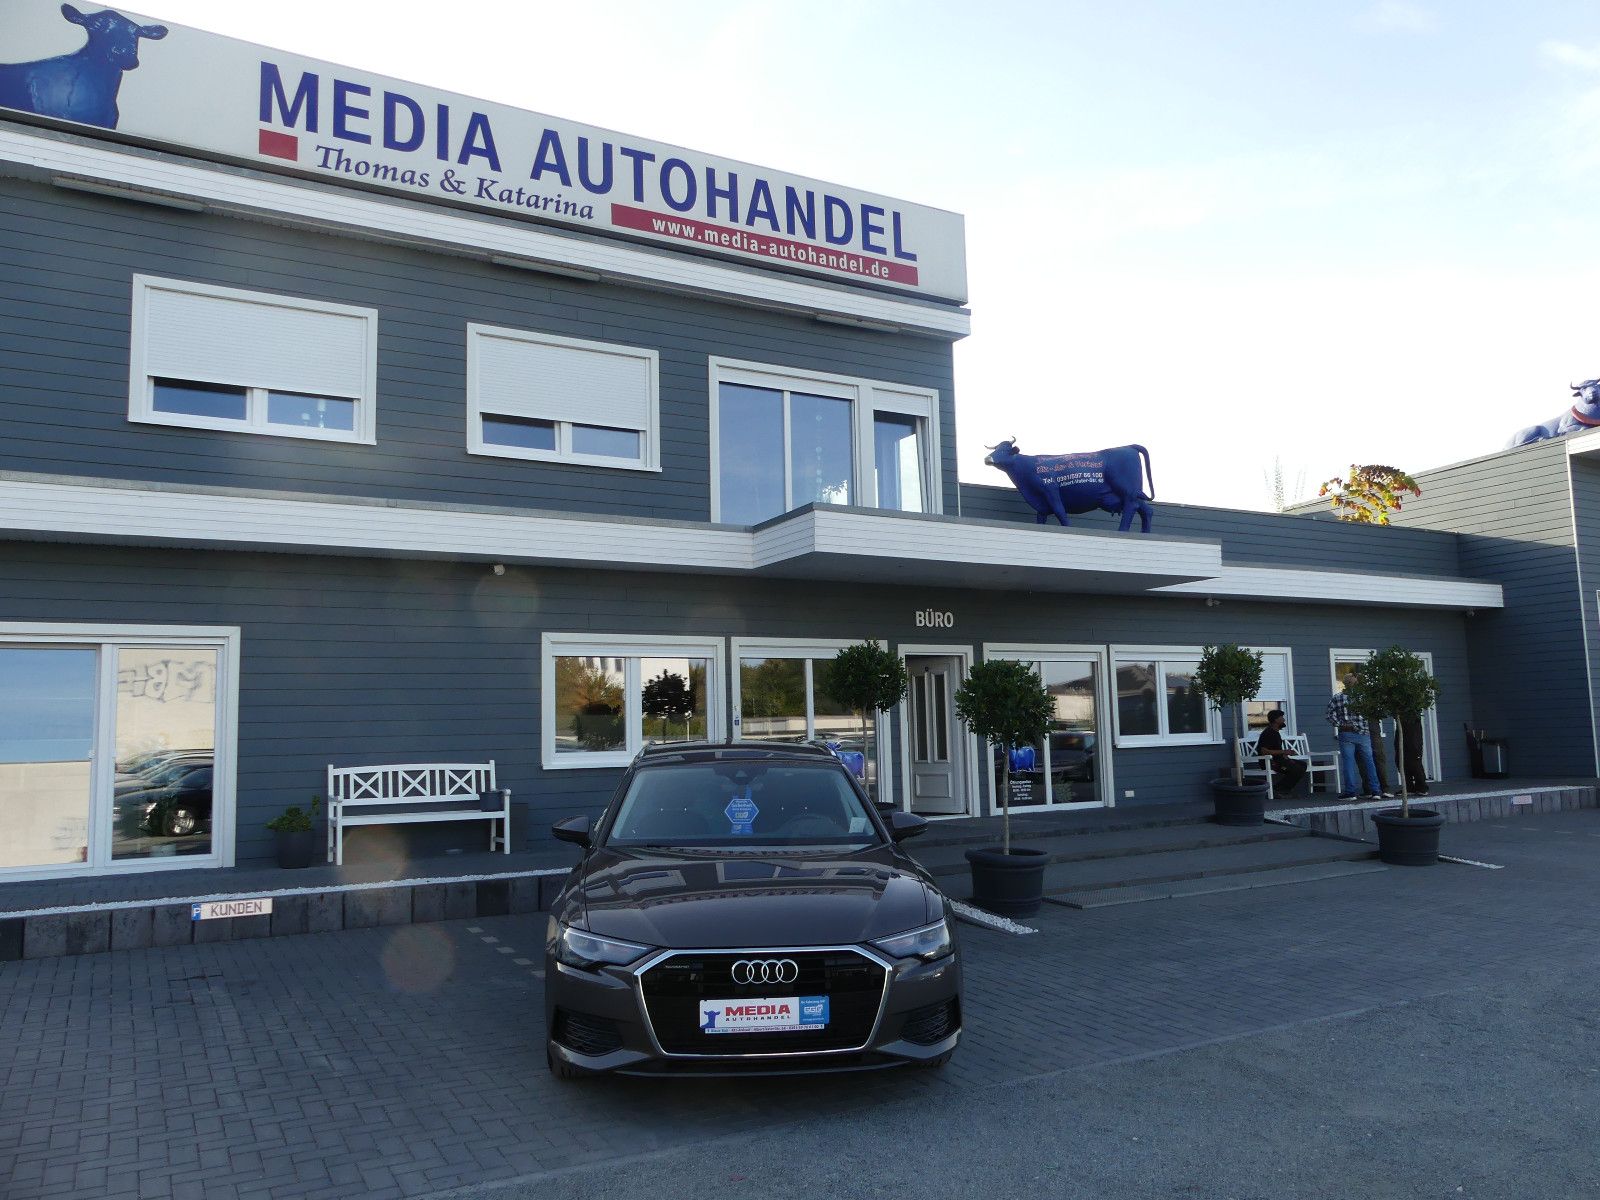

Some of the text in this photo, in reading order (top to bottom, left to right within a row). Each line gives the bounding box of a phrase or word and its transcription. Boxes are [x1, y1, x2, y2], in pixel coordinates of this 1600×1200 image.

[259, 60, 918, 262] MEDIA AUTOHANDEL
[315, 144, 595, 220] Thomas & Katarina
[651, 216, 890, 279] www.media-autohandel.de
[915, 608, 954, 627] BÜRO
[210, 901, 263, 917] KUNDEN
[725, 1004, 791, 1016] MEDIA
